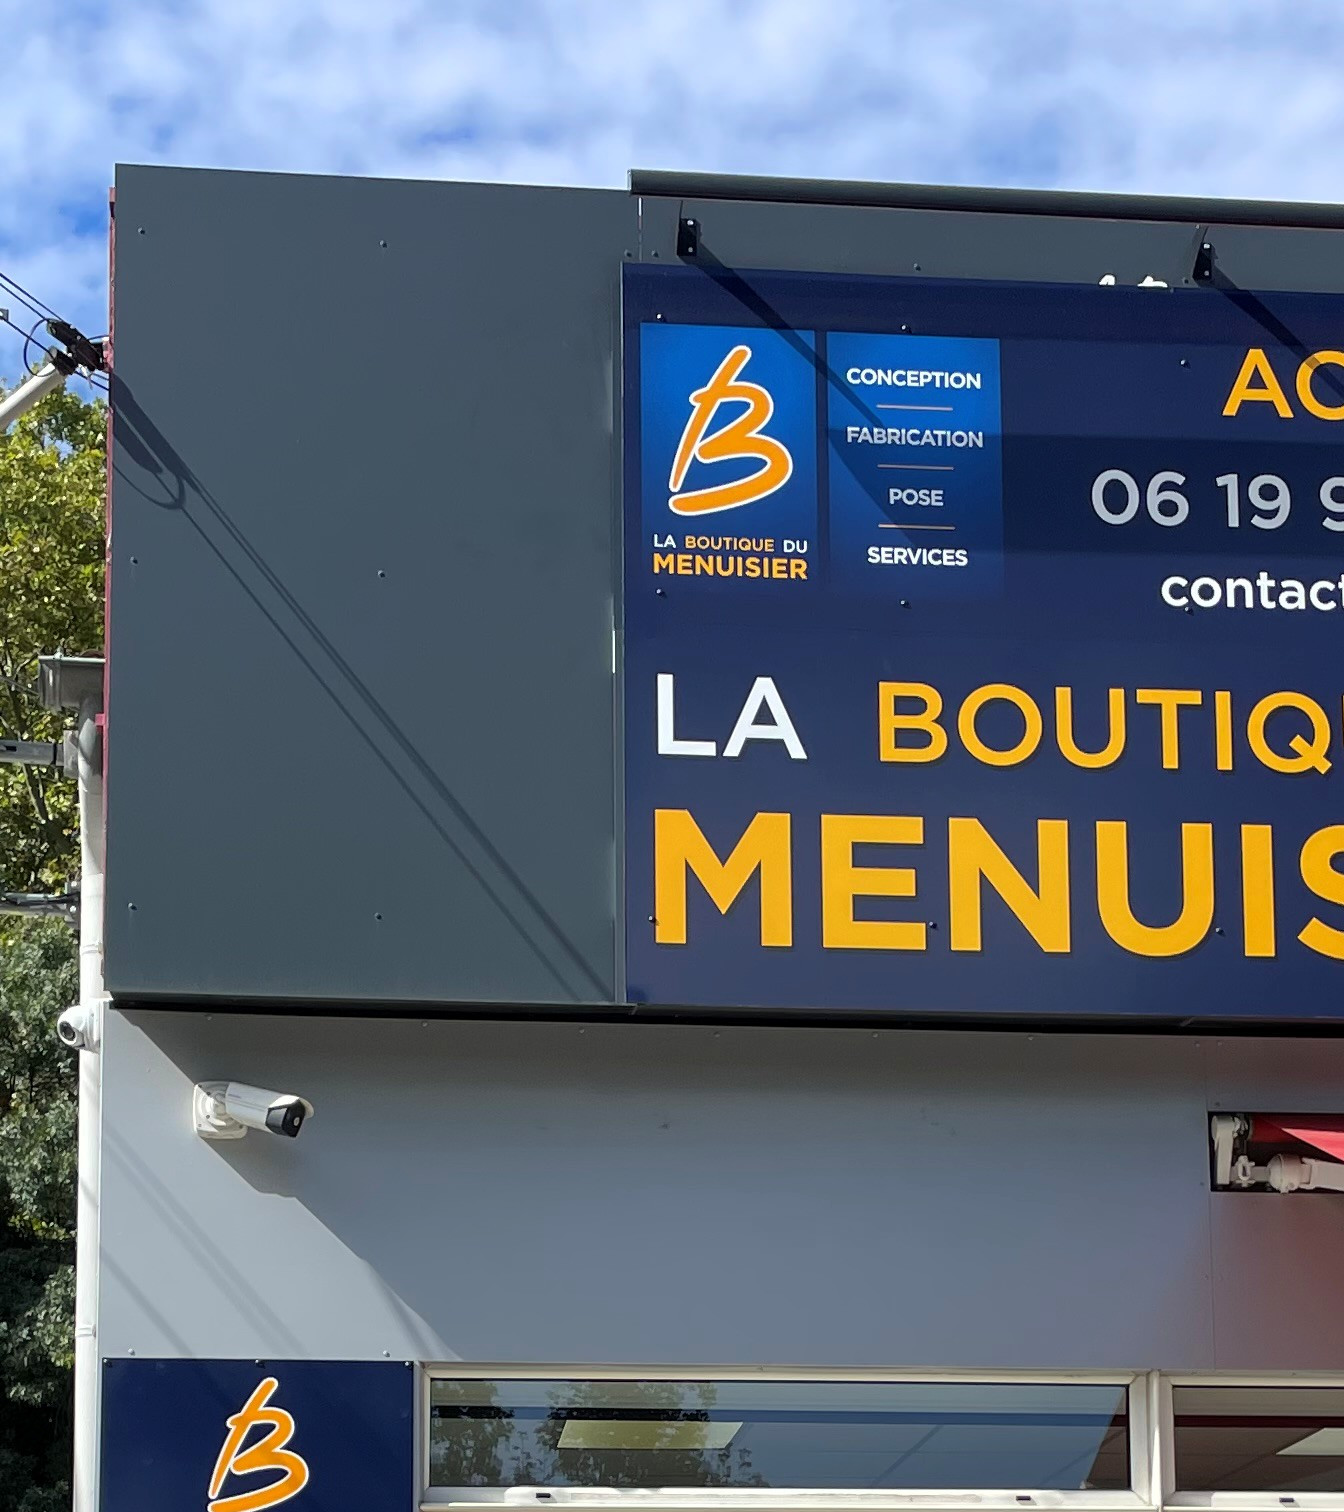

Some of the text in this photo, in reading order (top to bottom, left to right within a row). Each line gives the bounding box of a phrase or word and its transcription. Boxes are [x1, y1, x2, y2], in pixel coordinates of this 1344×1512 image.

[847, 368, 981, 389] CONCEPTION
[847, 426, 983, 447] FABRICATION
[890, 489, 943, 506] POSE
[1092, 470, 1189, 526] 06
[1216, 474, 1290, 529] 19
[654, 534, 807, 553] LA BOUTIQUE DU
[654, 551, 807, 579] MENUISIER
[868, 547, 968, 566] SERVICES
[657, 674, 807, 759] LA
